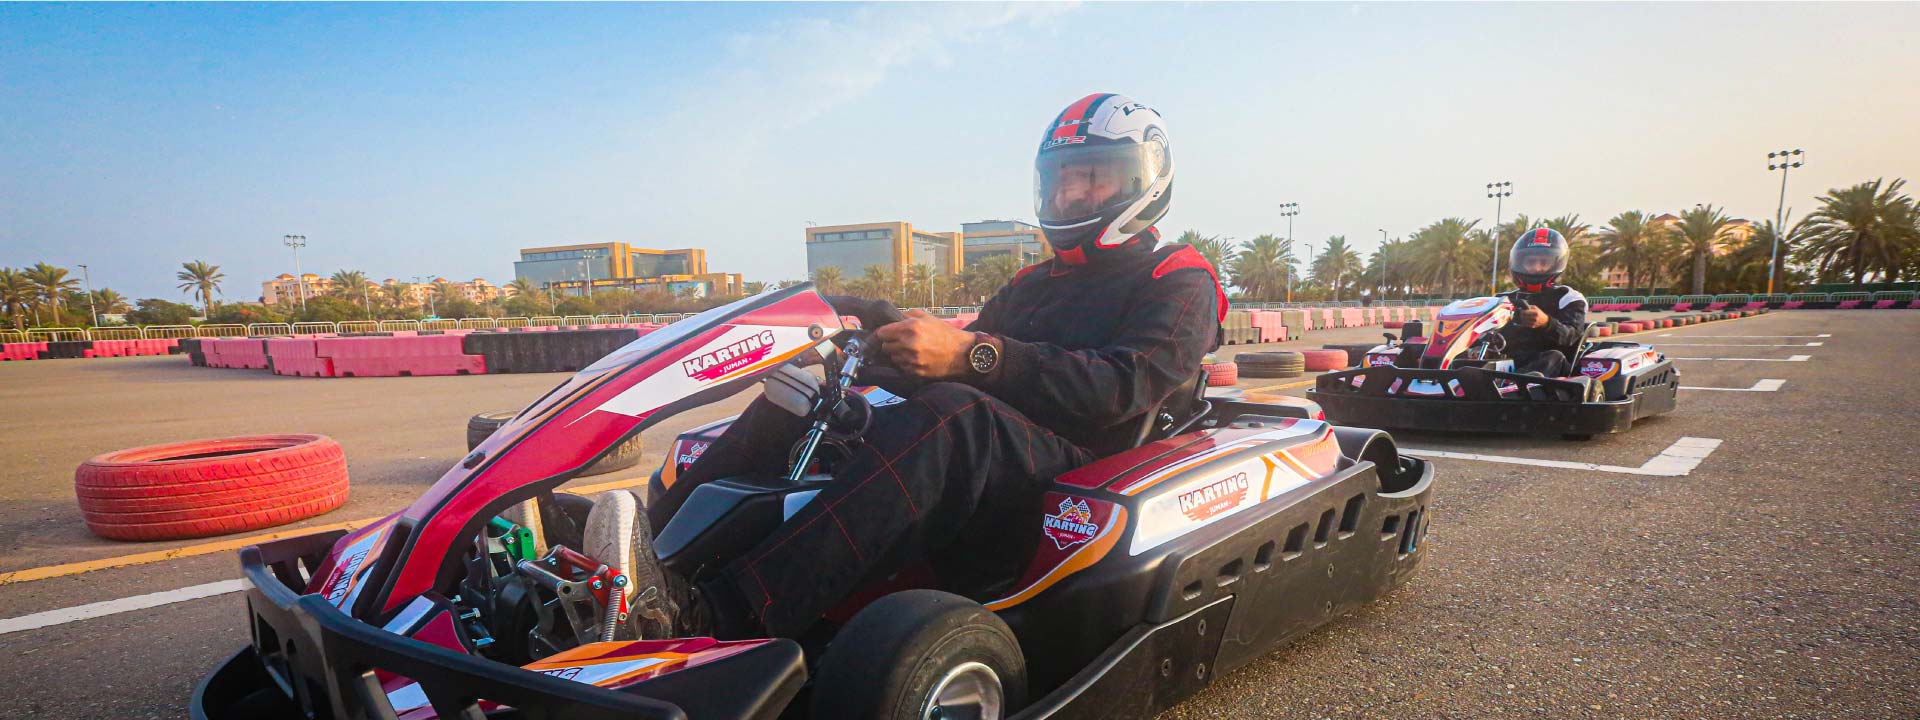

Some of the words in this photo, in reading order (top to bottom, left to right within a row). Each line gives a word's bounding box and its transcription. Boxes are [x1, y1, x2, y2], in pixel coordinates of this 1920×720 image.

[682, 330, 775, 377] KARTING
[723, 358, 747, 372] JUMAN
[1178, 472, 1248, 512] KARTING
[1209, 501, 1229, 515] JUMAN
[1045, 516, 1096, 537] KARTING
